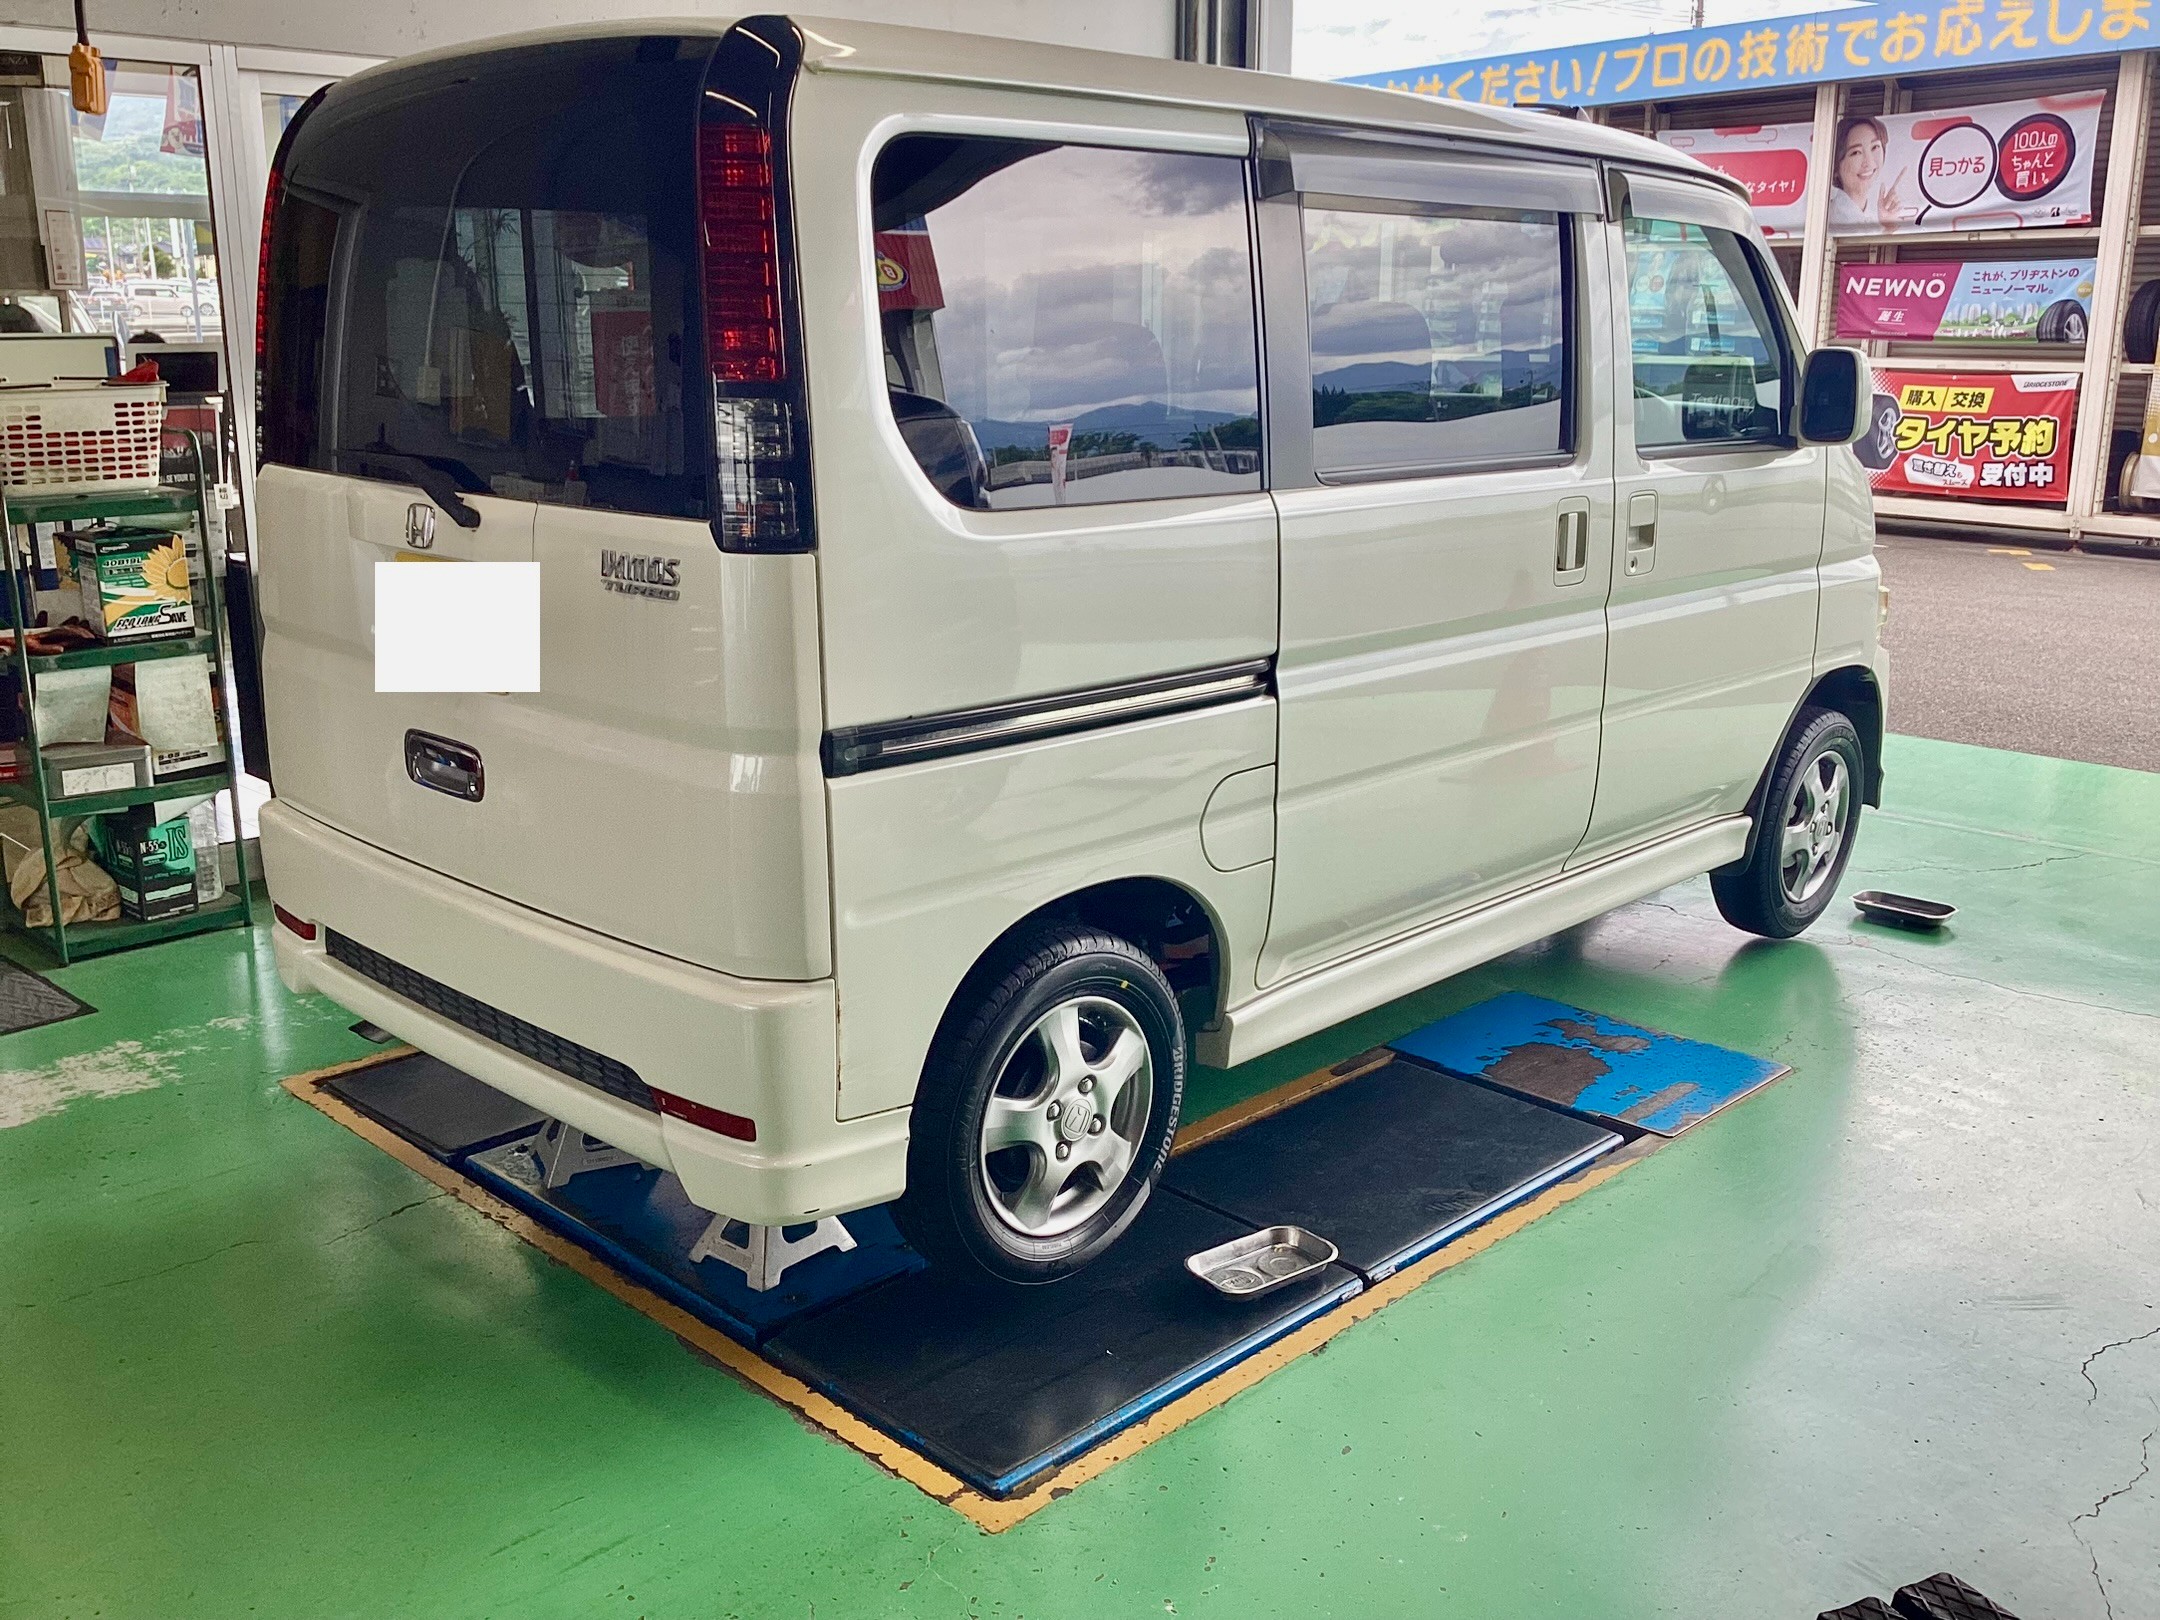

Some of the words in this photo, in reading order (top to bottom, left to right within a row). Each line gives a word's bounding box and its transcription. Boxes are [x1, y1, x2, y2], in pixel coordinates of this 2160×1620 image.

[2013, 131, 2058, 149] 100人の
[1928, 156, 1985, 178] 見つかる
[2012, 152, 2054, 170] ちゃんと
[2016, 171, 2050, 188] 買い。
[1972, 268, 2080, 282] これが、ブリヂストンの
[1846, 276, 1946, 298] NEWNO
[1971, 283, 2054, 295] ニューノーマル。
[2023, 380, 2068, 389] BRIDGESTONE
[1906, 390, 1938, 407] 購入
[1951, 391, 1986, 408] 交換
[1895, 416, 2059, 458] タイヤ予約
[1979, 462, 2054, 489] 受付中
[600, 579, 681, 601] TURBO
[158, 604, 188, 625] SAVE
[1153, 1046, 1184, 1174] BRIDGESTONE
